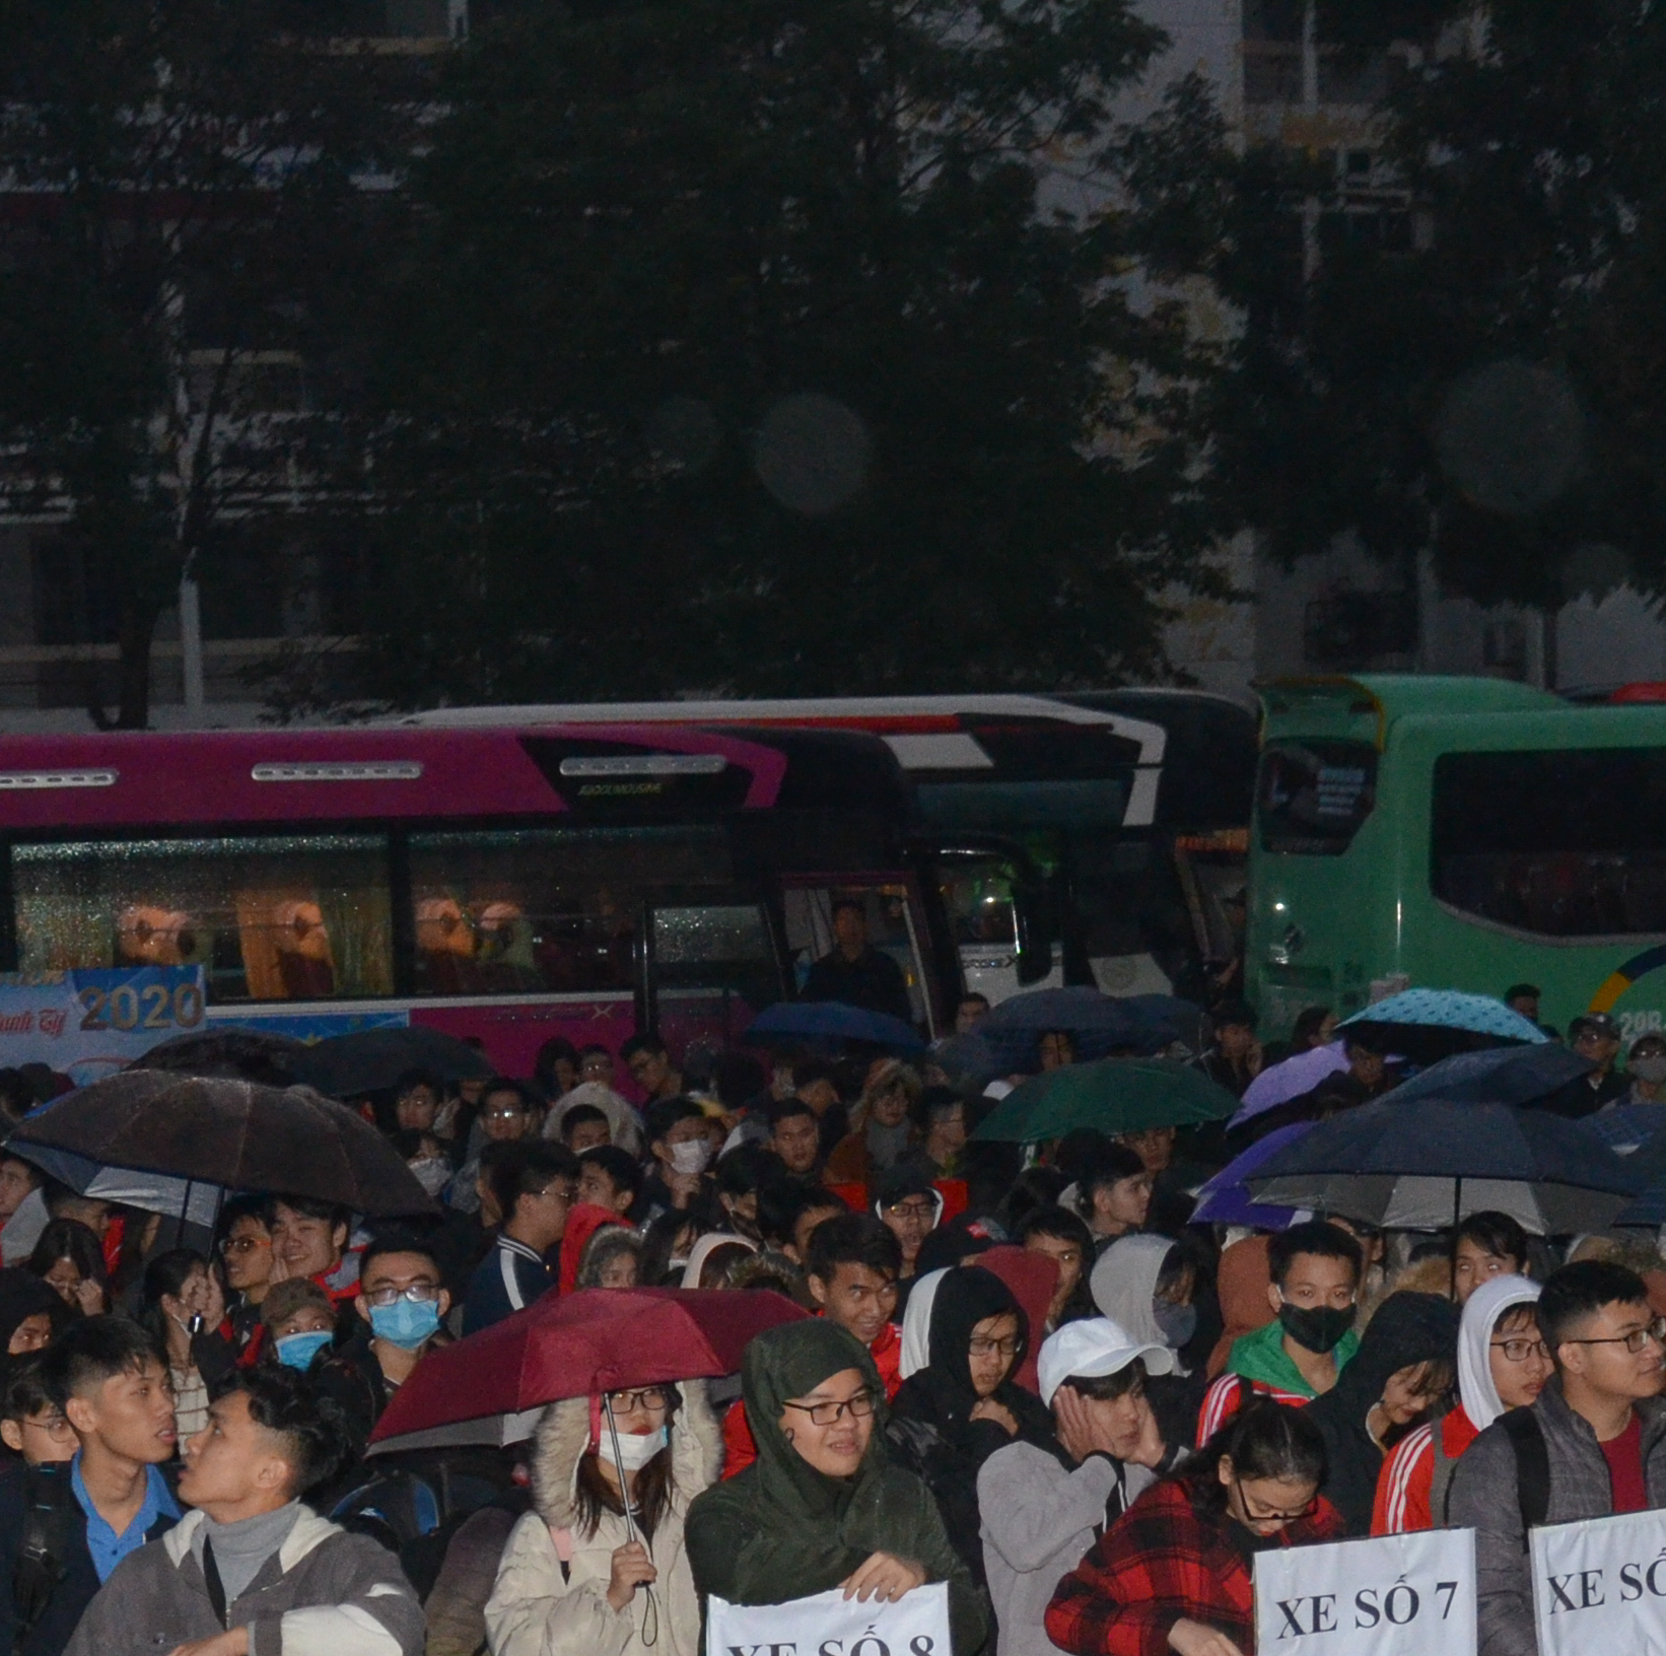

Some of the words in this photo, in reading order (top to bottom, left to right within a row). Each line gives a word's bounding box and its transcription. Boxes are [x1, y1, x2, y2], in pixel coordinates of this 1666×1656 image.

[79, 983, 204, 1031] 2020
[1276, 1594, 1338, 1640] XE
[1355, 1575, 1420, 1629] SỐ
[1435, 1580, 1458, 1621] 7
[1547, 1570, 1605, 1615] XE
